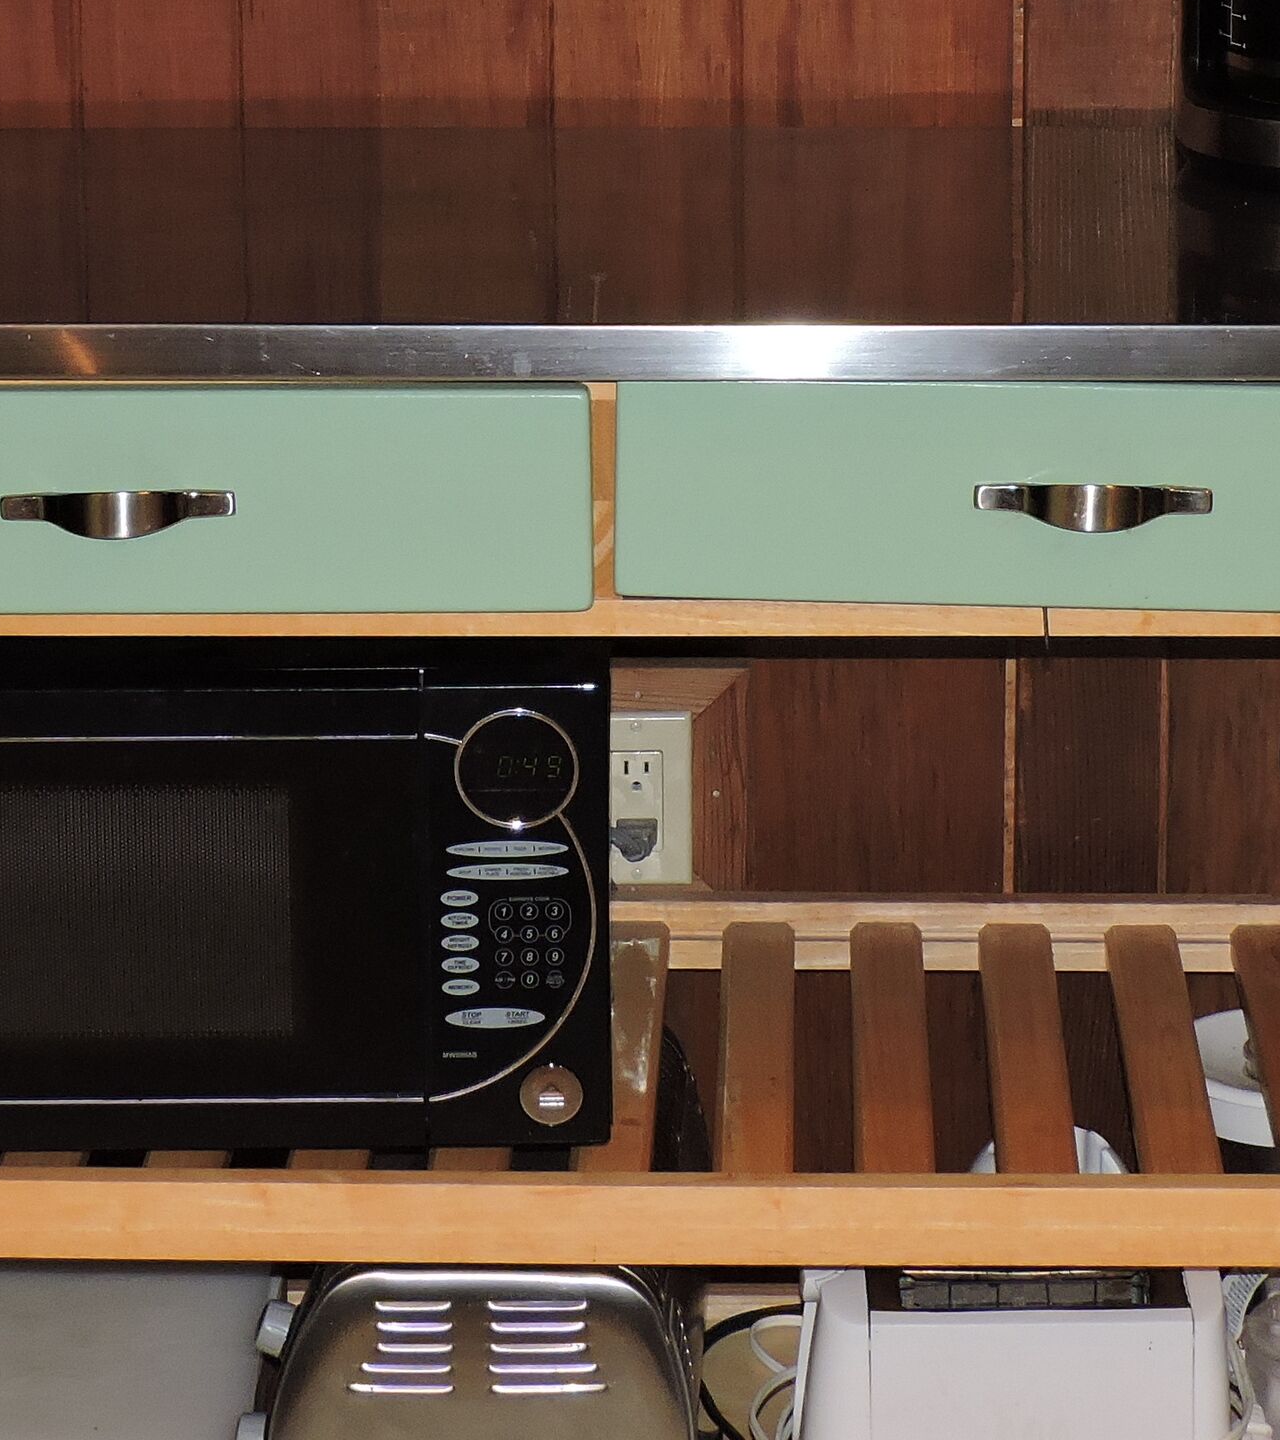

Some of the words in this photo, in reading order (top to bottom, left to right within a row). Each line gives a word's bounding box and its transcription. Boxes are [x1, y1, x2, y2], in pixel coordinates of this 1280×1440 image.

[501, 906, 507, 917] 1
[526, 906, 533, 916] 2
[551, 906, 558, 916] 3
[501, 929, 508, 939] 4
[526, 929, 533, 939] 5
[551, 929, 558, 939] 6
[501, 952, 508, 962] 7
[526, 952, 533, 962] 8
[552, 951, 559, 962] 9
[526, 974, 534, 984] 0
